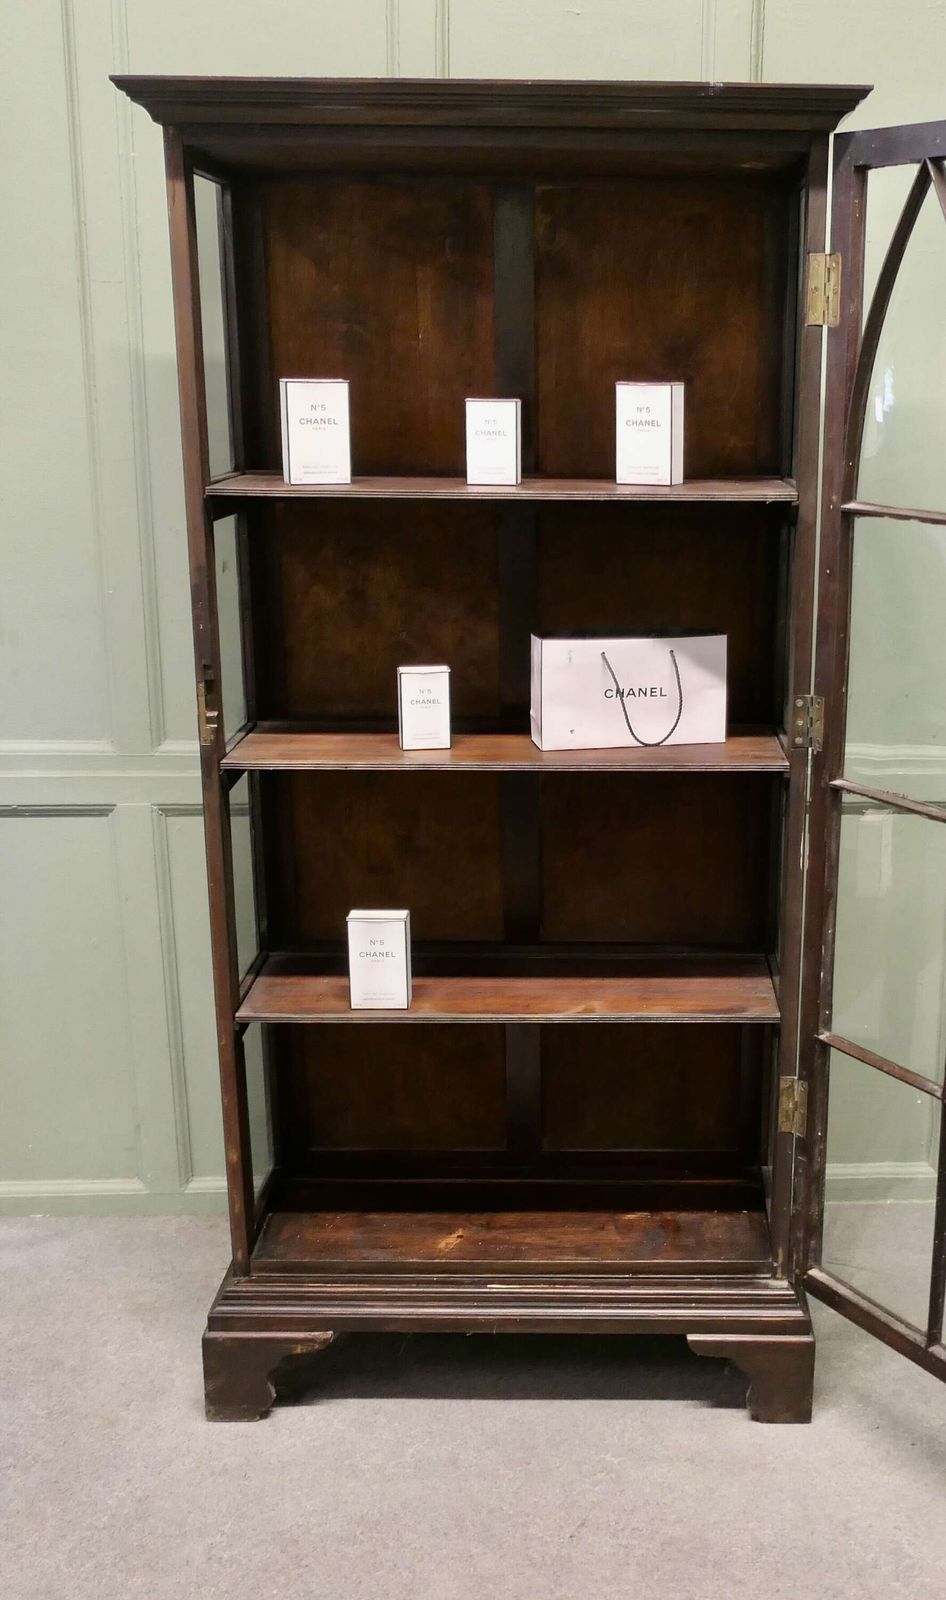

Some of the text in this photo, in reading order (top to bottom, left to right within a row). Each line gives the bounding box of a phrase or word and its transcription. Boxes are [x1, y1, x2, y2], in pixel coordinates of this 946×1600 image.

[625, 419, 661, 427] CHANEL
[604, 687, 667, 699] CHANEL
[410, 698, 441, 706] CHANEL
